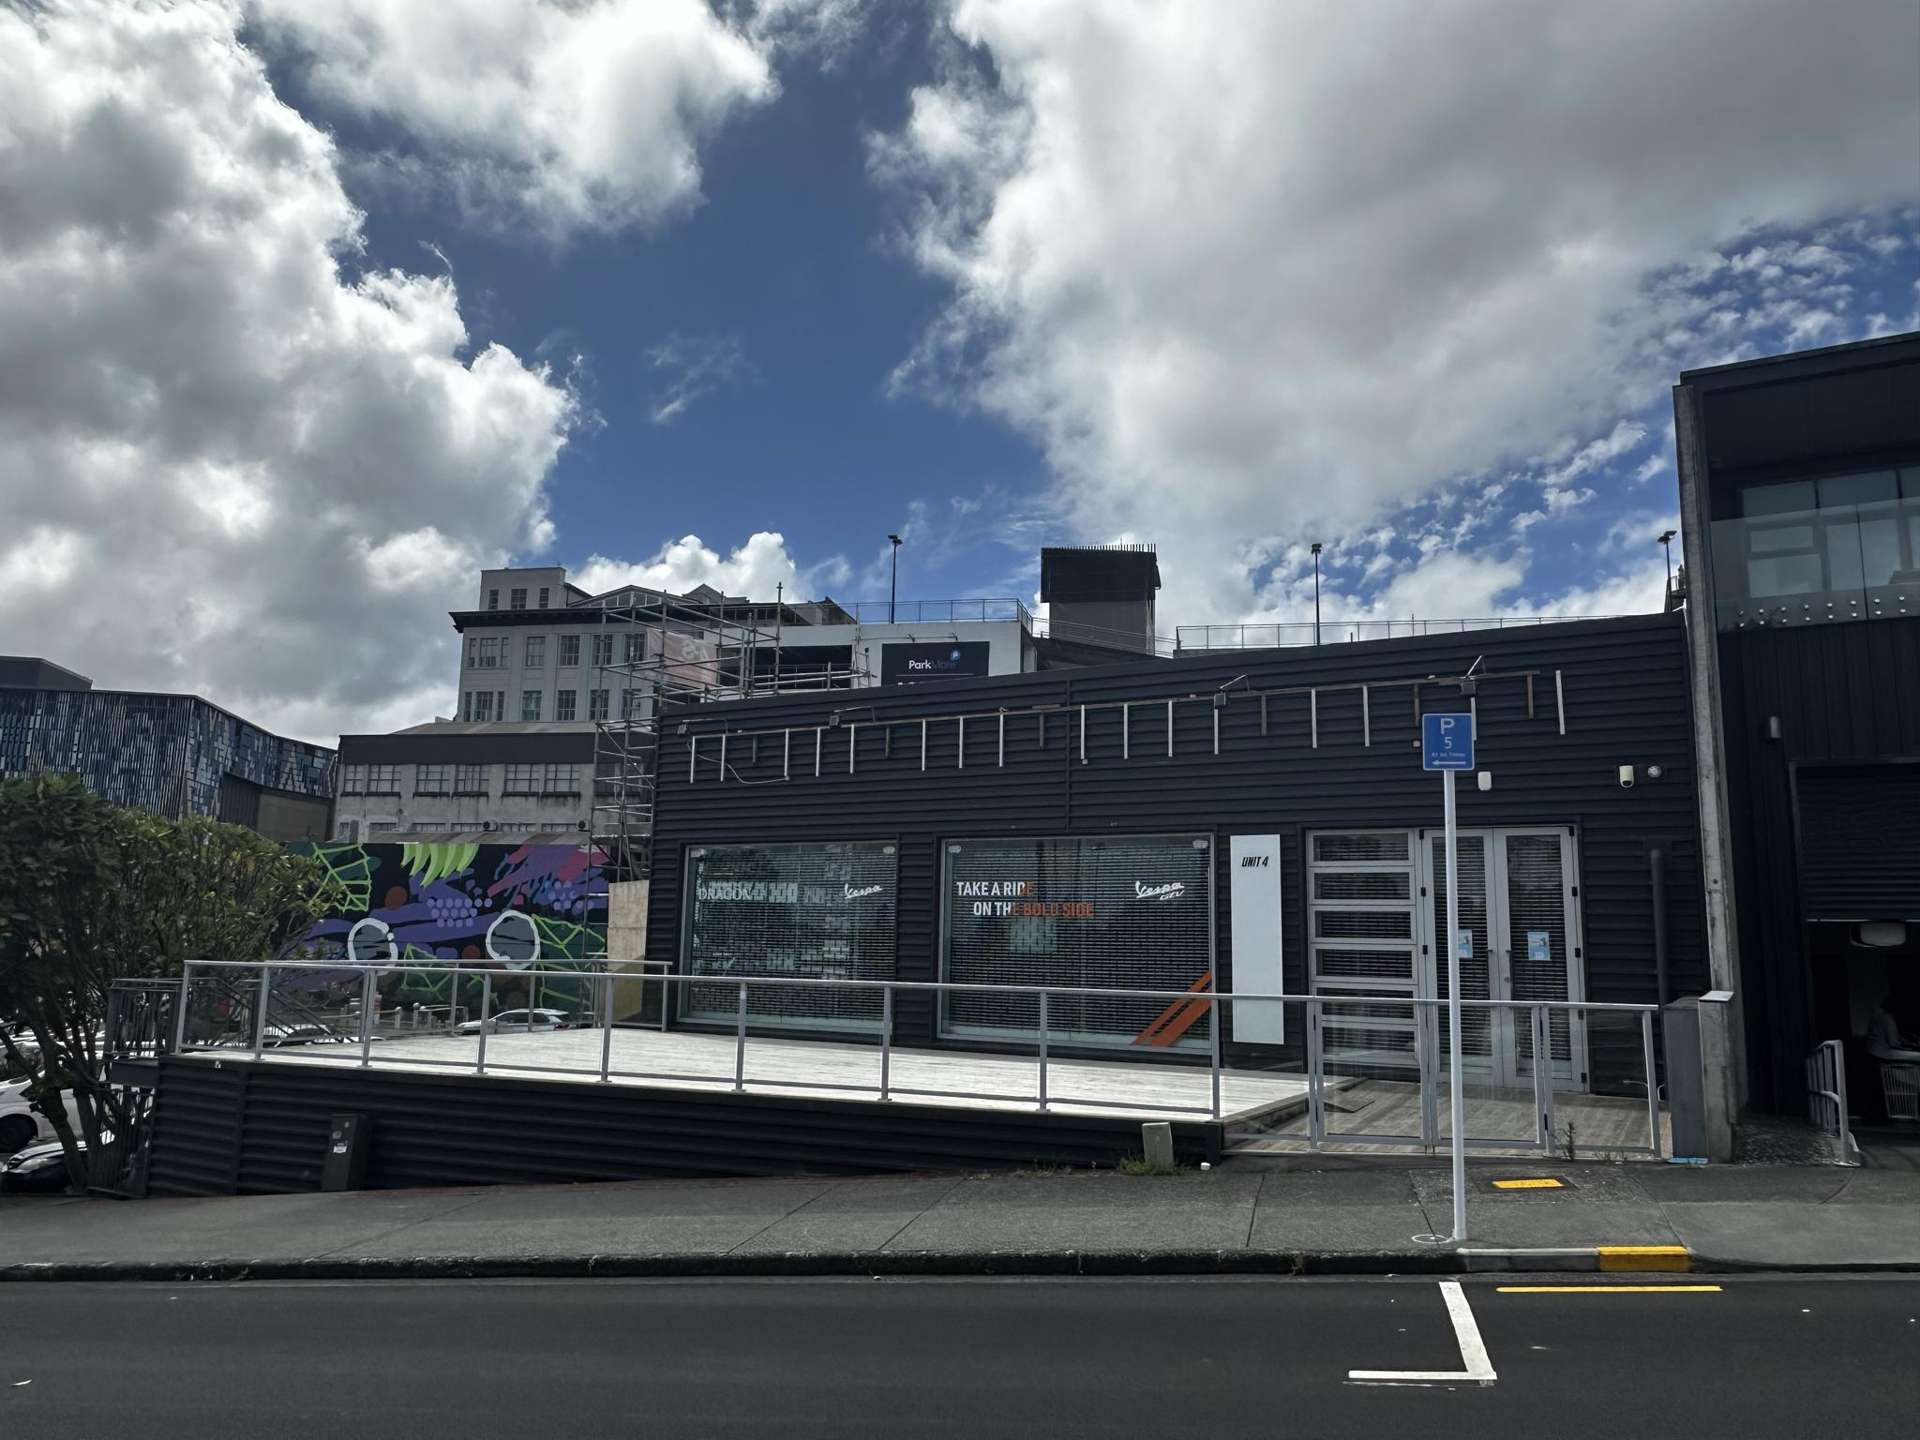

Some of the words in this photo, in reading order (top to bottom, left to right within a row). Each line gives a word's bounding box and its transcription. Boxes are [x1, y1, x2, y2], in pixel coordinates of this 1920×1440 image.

[1440, 718, 1455, 735] P
[1444, 736, 1453, 750] 5
[1241, 856, 1261, 867] UNIT
[1262, 856, 1269, 867] 4
[844, 882, 884, 900] Vespa
[956, 881, 989, 896] TAKE
[991, 881, 1001, 896] A
[1003, 881, 1034, 896] RIDE
[1135, 880, 1185, 899] Vespa
[973, 901, 992, 916] ON
[994, 901, 1021, 916] THE
[1062, 902, 1094, 917] SIDE
